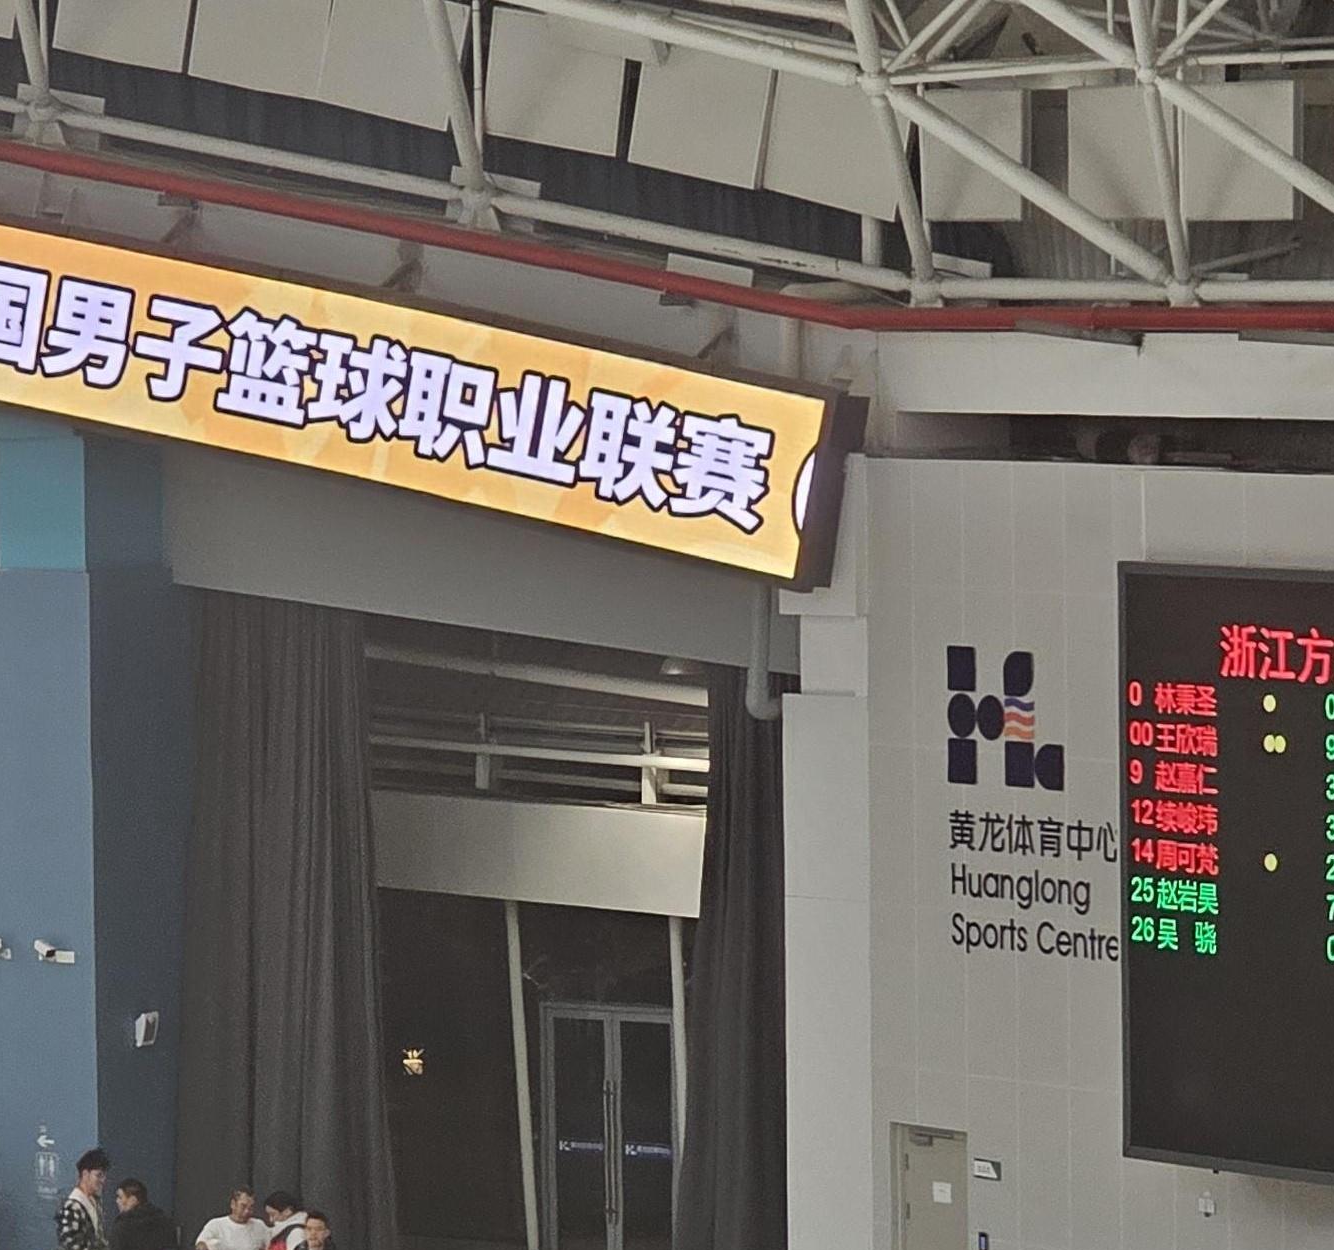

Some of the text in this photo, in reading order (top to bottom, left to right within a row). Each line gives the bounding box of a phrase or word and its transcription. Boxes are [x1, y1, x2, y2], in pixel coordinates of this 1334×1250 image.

[1129, 682, 1142, 706] 0
[1130, 760, 1143, 784] 9
[949, 810, 1117, 863] 黄龙体育中心
[951, 863, 1091, 916] Huanglong
[1156, 878, 1219, 915] 赵岩昊
[952, 912, 1119, 962] Sports Centre
